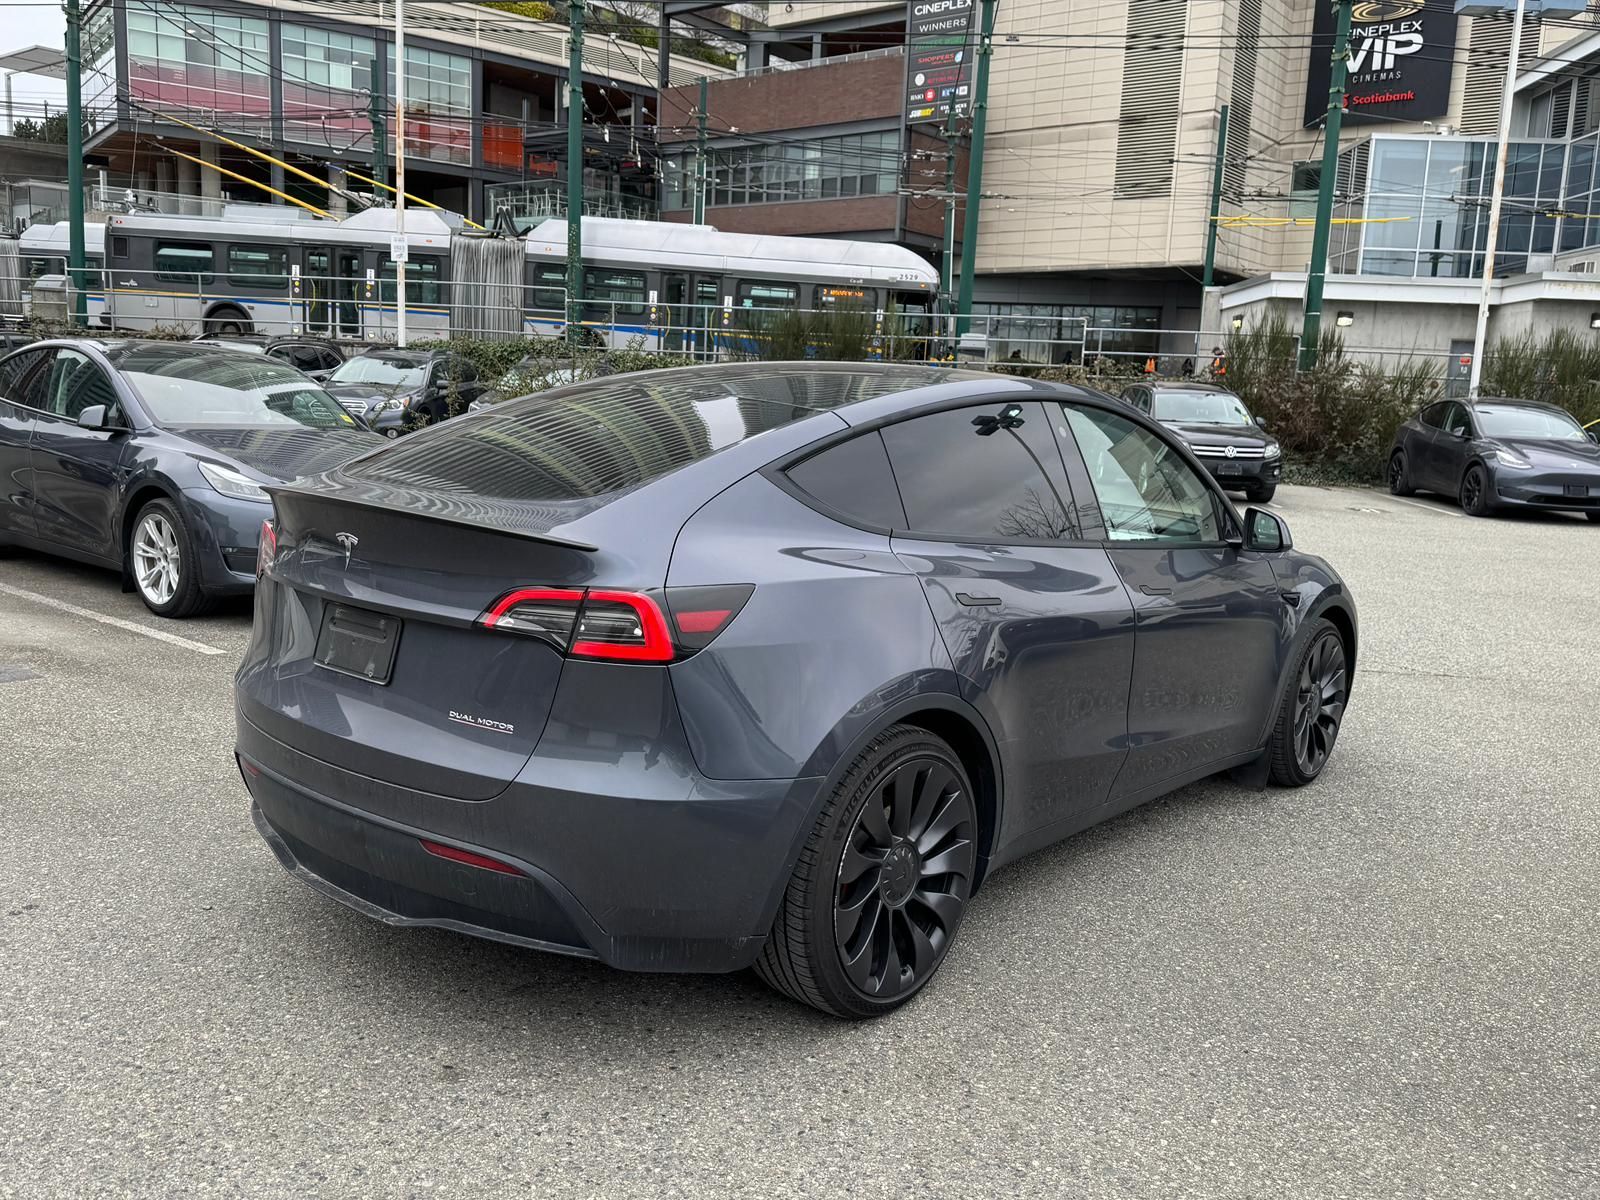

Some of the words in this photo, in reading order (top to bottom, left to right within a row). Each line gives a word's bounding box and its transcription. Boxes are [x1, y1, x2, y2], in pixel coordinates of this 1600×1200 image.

[914, 0, 972, 15] CINEPLEX
[919, 18, 967, 32] WINNERS
[1350, 20, 1423, 38] INEPLEX
[1346, 33, 1424, 73] VIP
[1352, 71, 1402, 83] CINEMAS
[1352, 91, 1415, 105] Scotiabank
[449, 710, 475, 722] DUAL
[477, 717, 514, 731] MOTOR
[842, 766, 879, 824] MICHELIN
